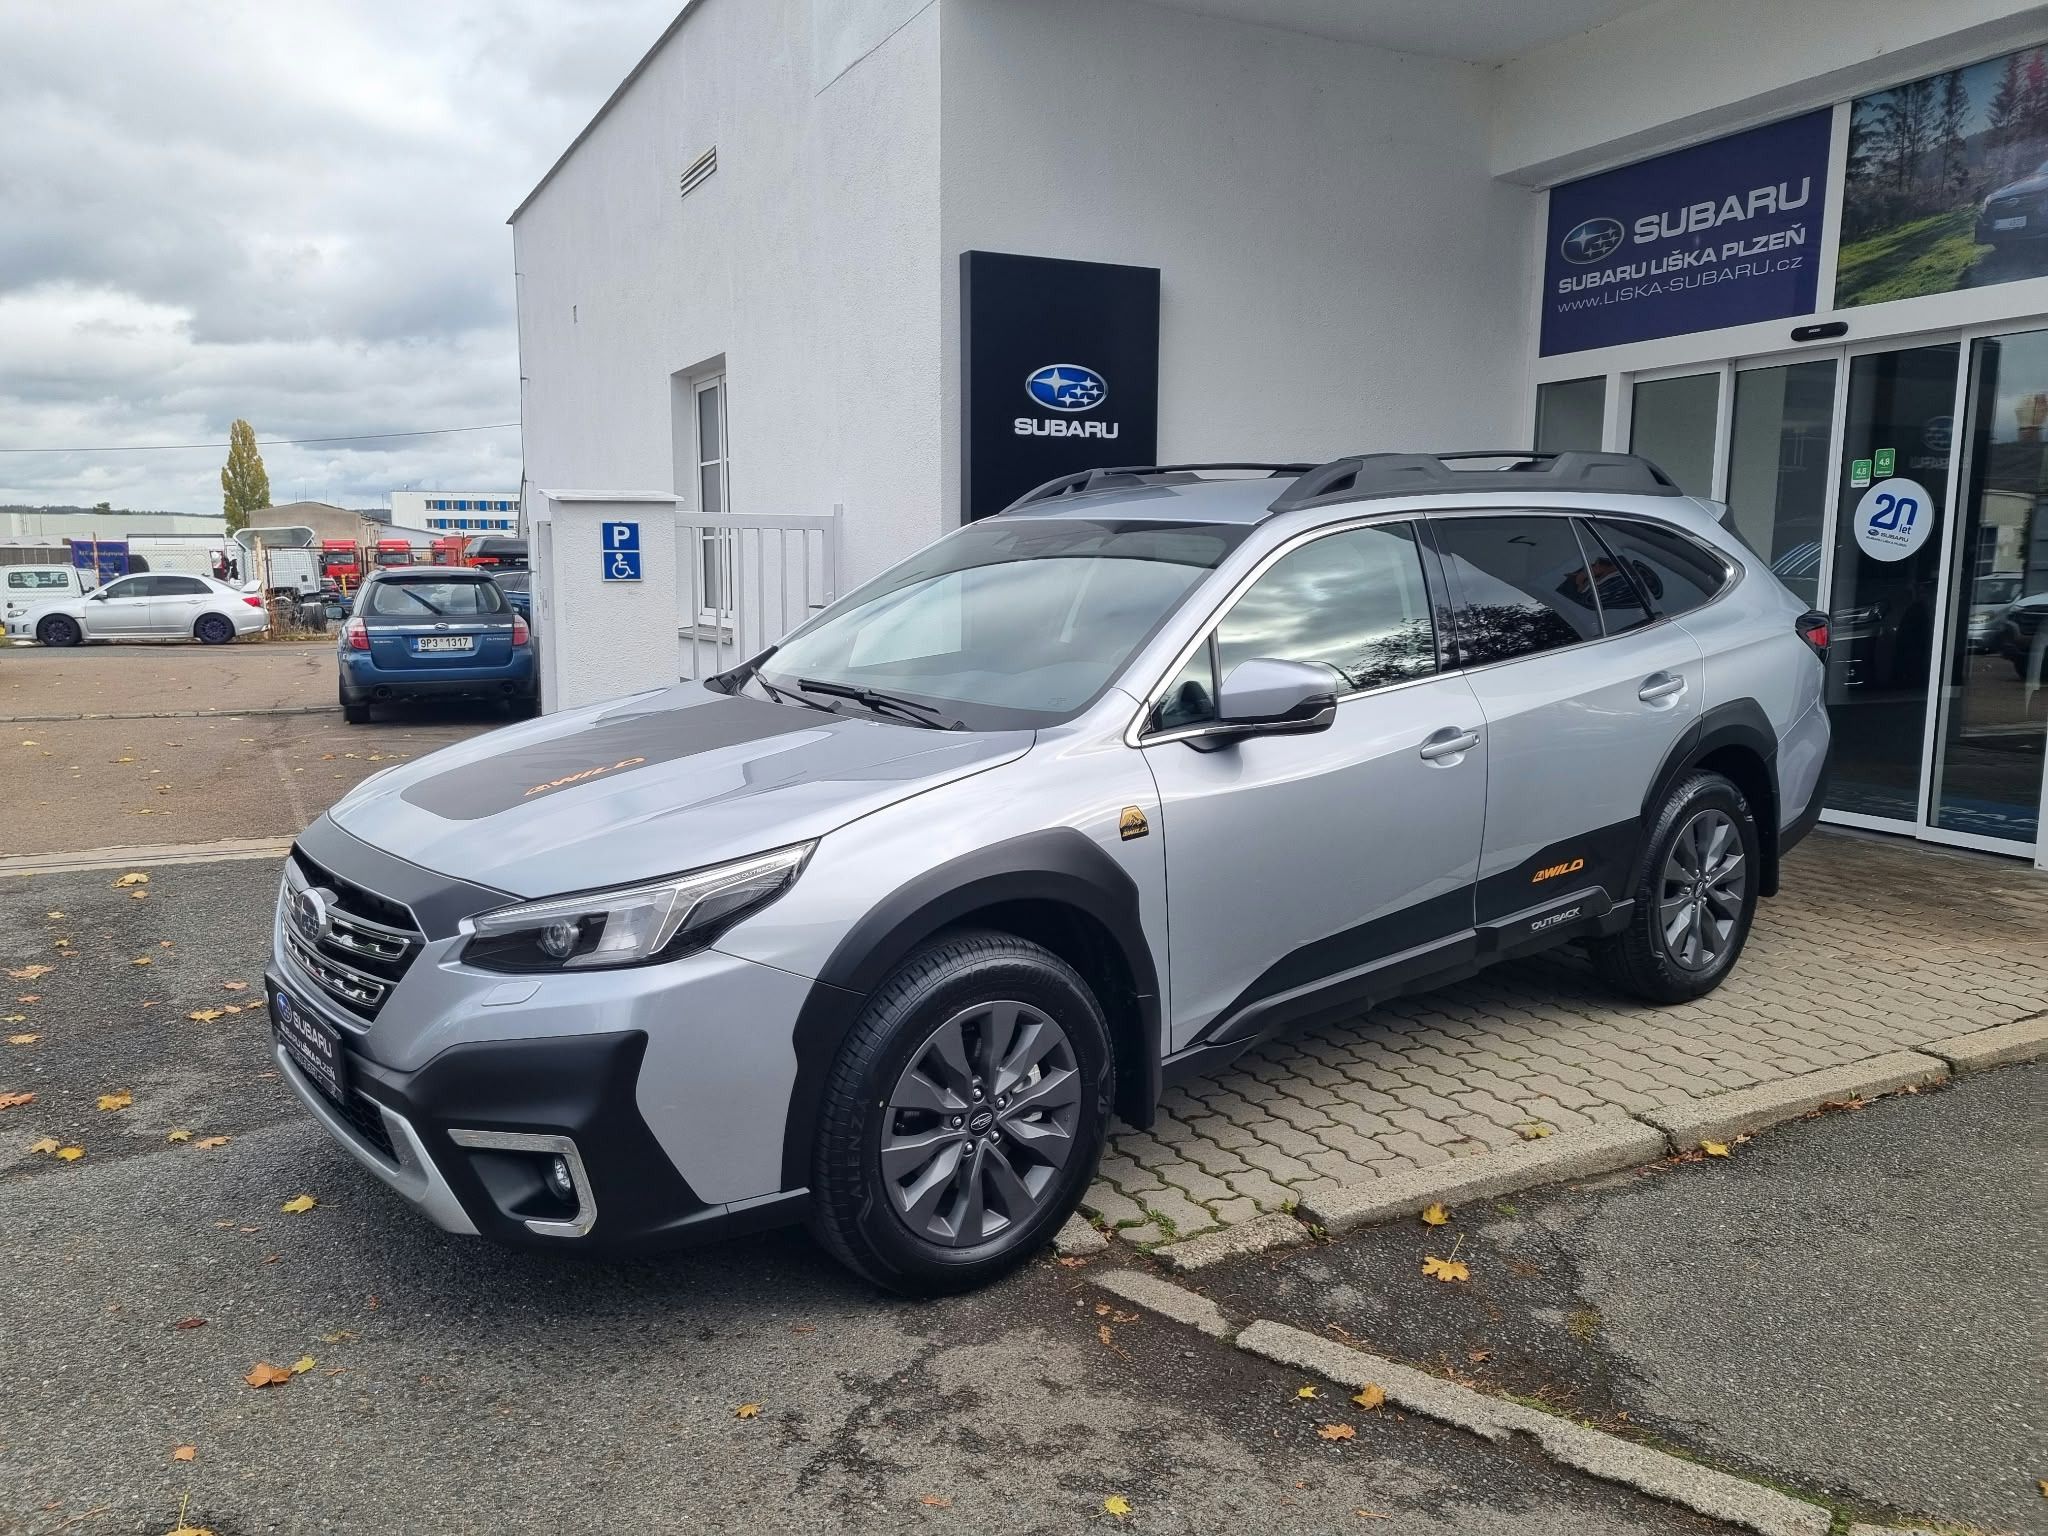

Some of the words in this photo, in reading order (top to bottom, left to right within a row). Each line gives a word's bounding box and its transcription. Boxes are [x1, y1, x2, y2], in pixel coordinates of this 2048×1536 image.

[1633, 176, 1811, 244] SUBARU
[1558, 261, 1647, 294] SUBARU
[1650, 249, 1717, 275] LIŠKA
[1721, 222, 1806, 261] PLZEŇ
[1014, 417, 1119, 439] SUBARU
[612, 526, 630, 548] P
[1898, 523, 1912, 535] let
[420, 638, 438, 648] 9P3
[445, 637, 469, 647] 1317
[1531, 907, 1580, 930] OUTBACK
[293, 1010, 333, 1059] SUBARU
